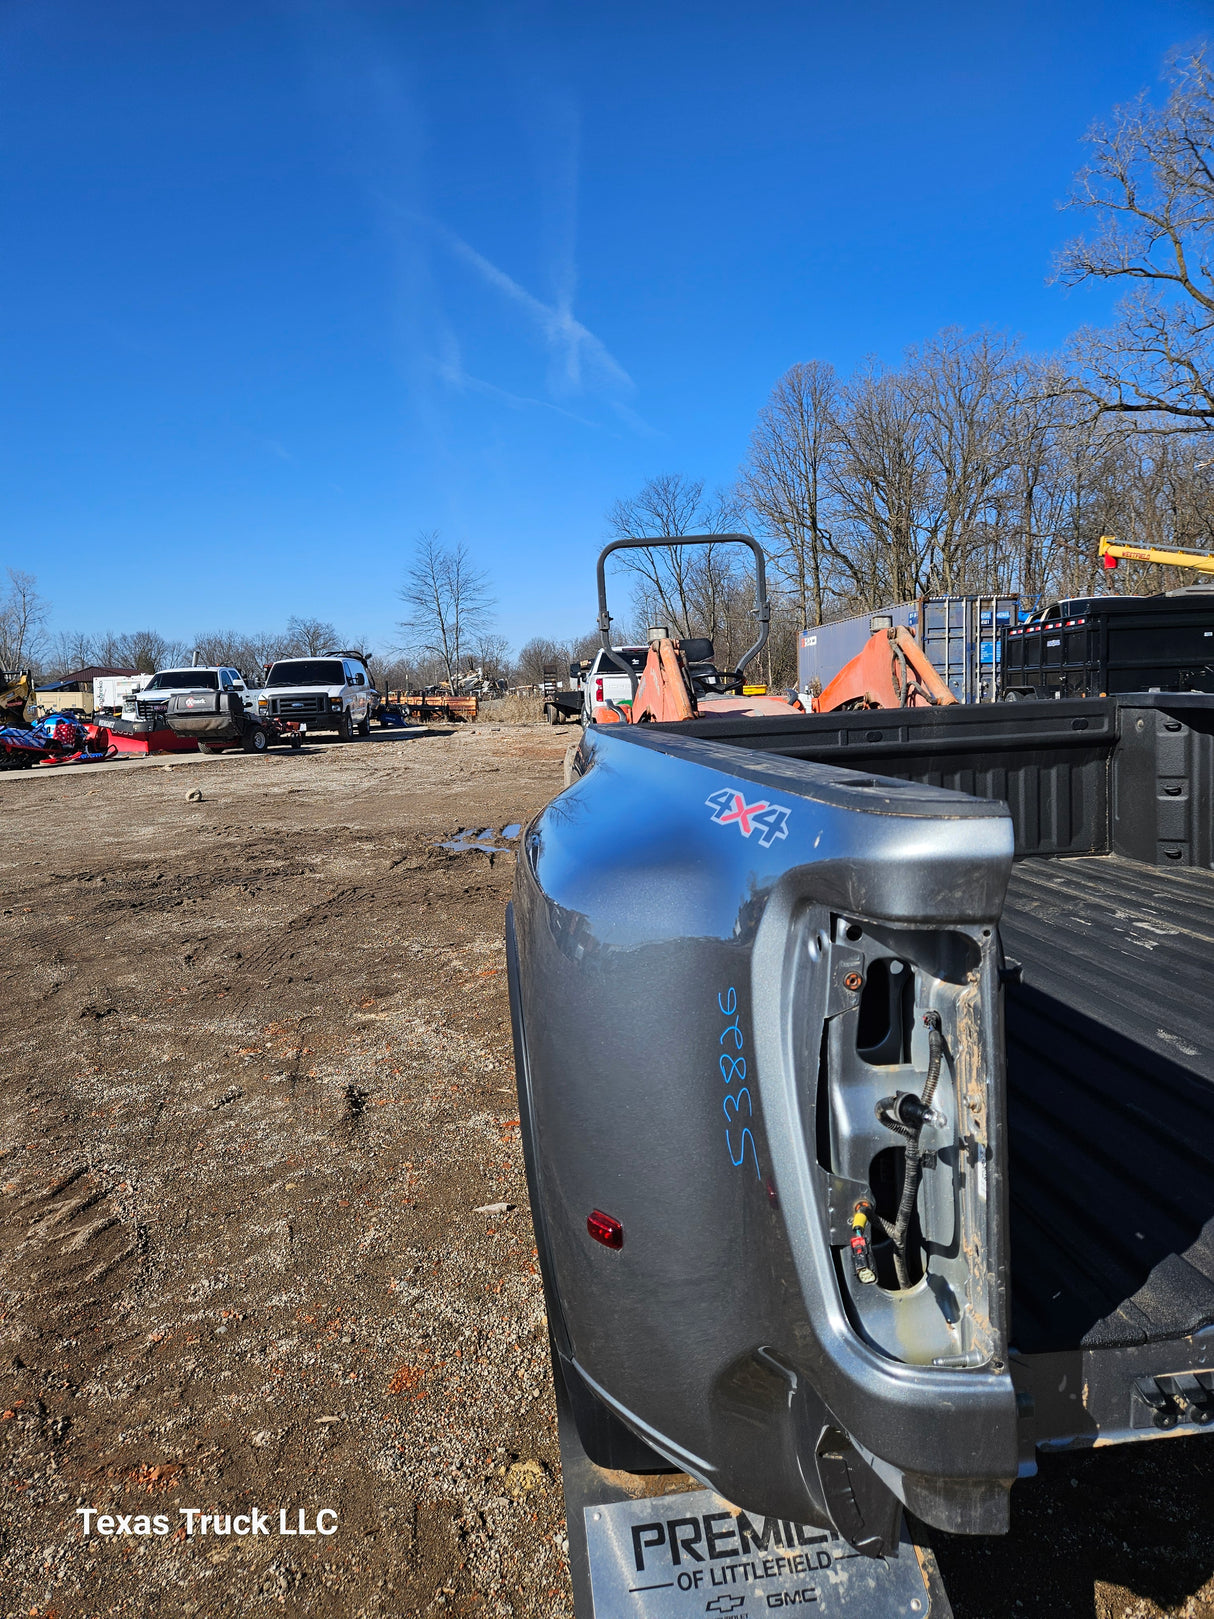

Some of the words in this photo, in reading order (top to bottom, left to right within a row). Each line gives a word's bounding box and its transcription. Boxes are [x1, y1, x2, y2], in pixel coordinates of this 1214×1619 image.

[631, 1510, 840, 1572] PREMI
[677, 1571, 704, 1592] OF
[710, 1550, 832, 1587] LITTLEFIELD
[766, 1588, 818, 1608] GMC
